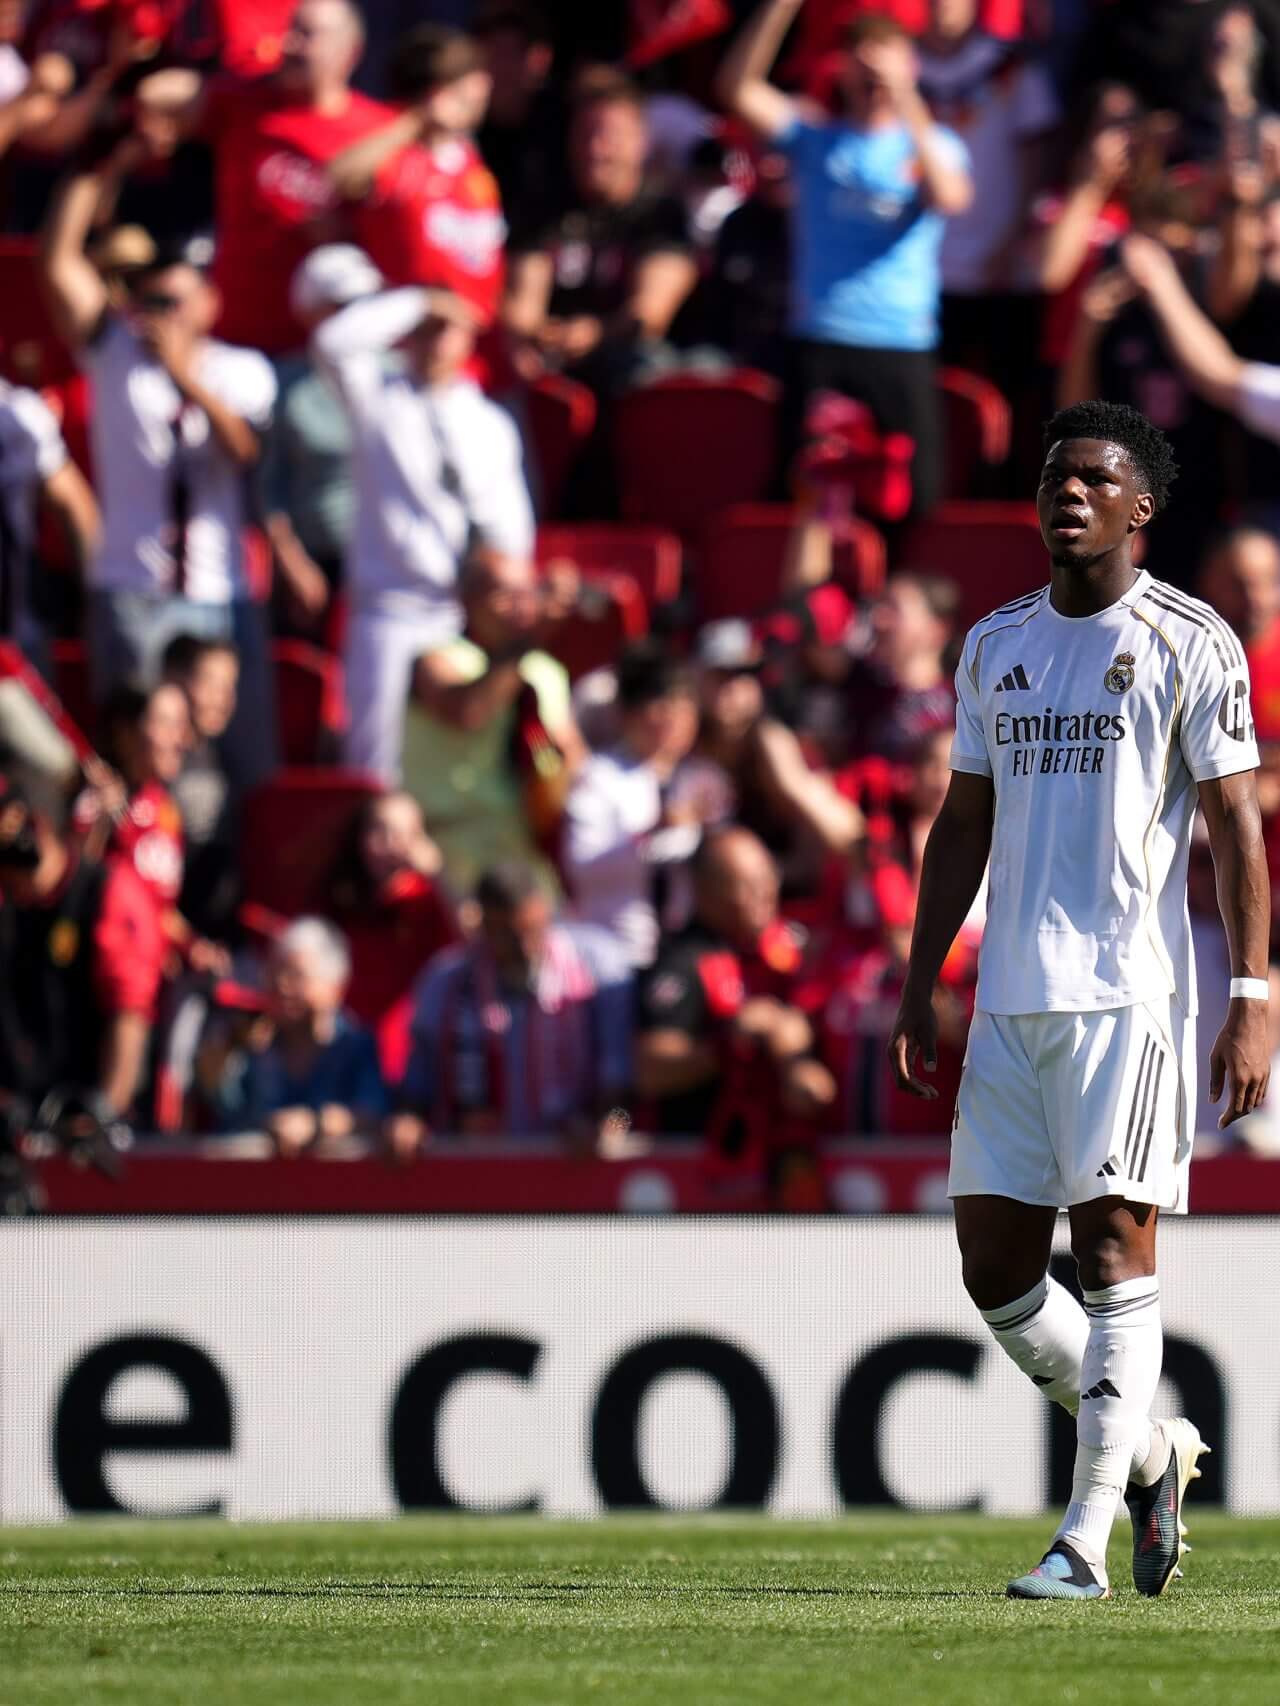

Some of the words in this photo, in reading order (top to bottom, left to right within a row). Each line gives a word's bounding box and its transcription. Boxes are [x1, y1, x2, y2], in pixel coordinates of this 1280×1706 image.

[995, 707, 1126, 746] Emirates
[1013, 748, 1037, 776] FLY
[1040, 746, 1105, 774] BETTER
[52, 1328, 232, 1514] e
